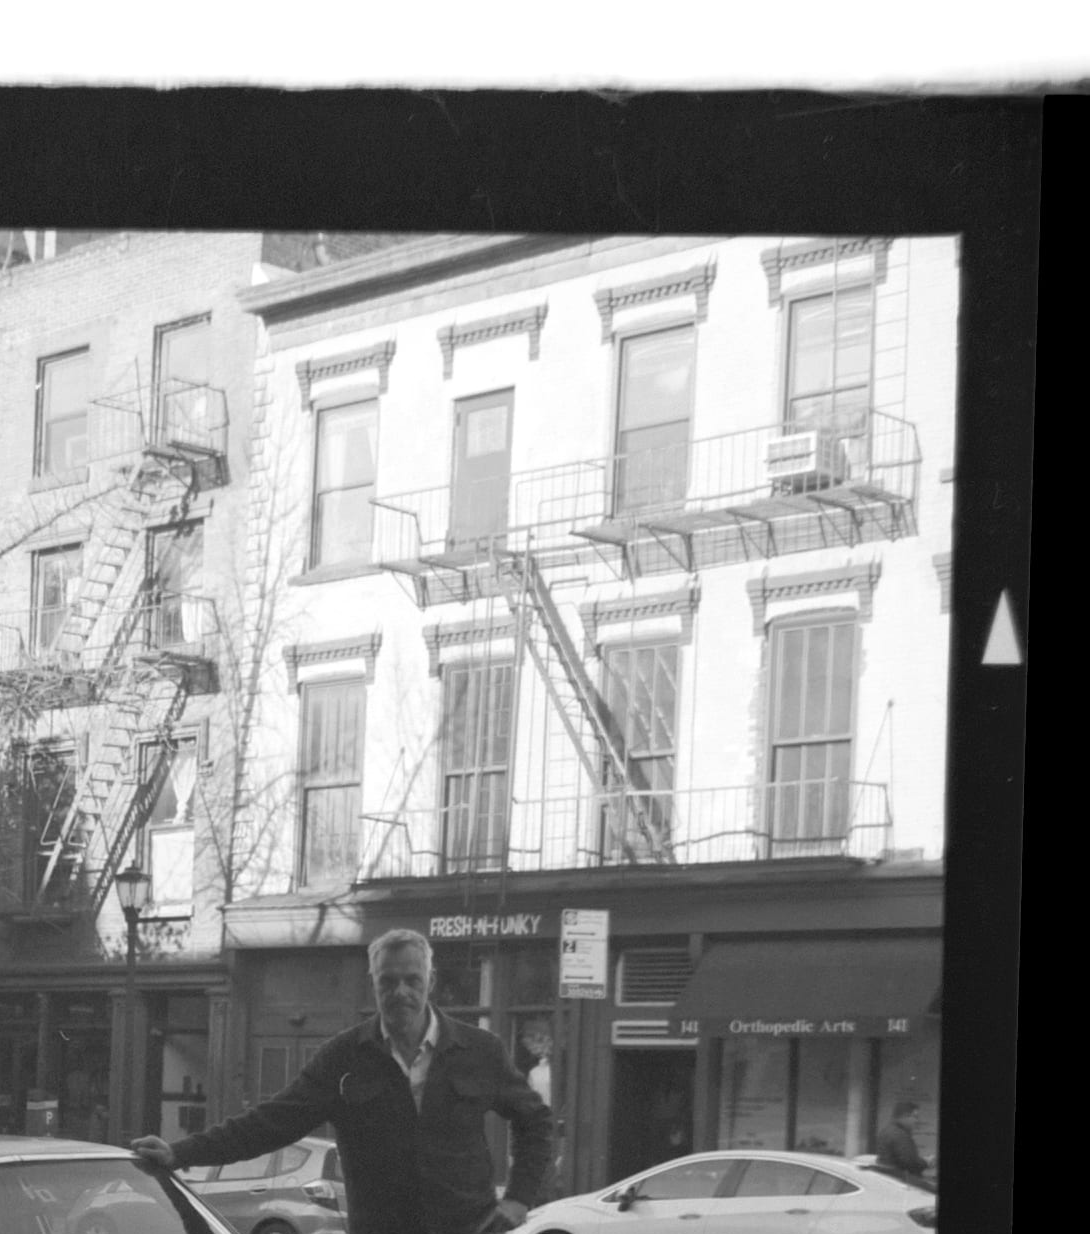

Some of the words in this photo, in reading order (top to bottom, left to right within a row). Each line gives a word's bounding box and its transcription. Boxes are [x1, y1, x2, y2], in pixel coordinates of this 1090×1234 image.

[681, 1020, 699, 1034] 141
[729, 1019, 814, 1036] Orthopedic
[820, 1020, 857, 1033] Arts
